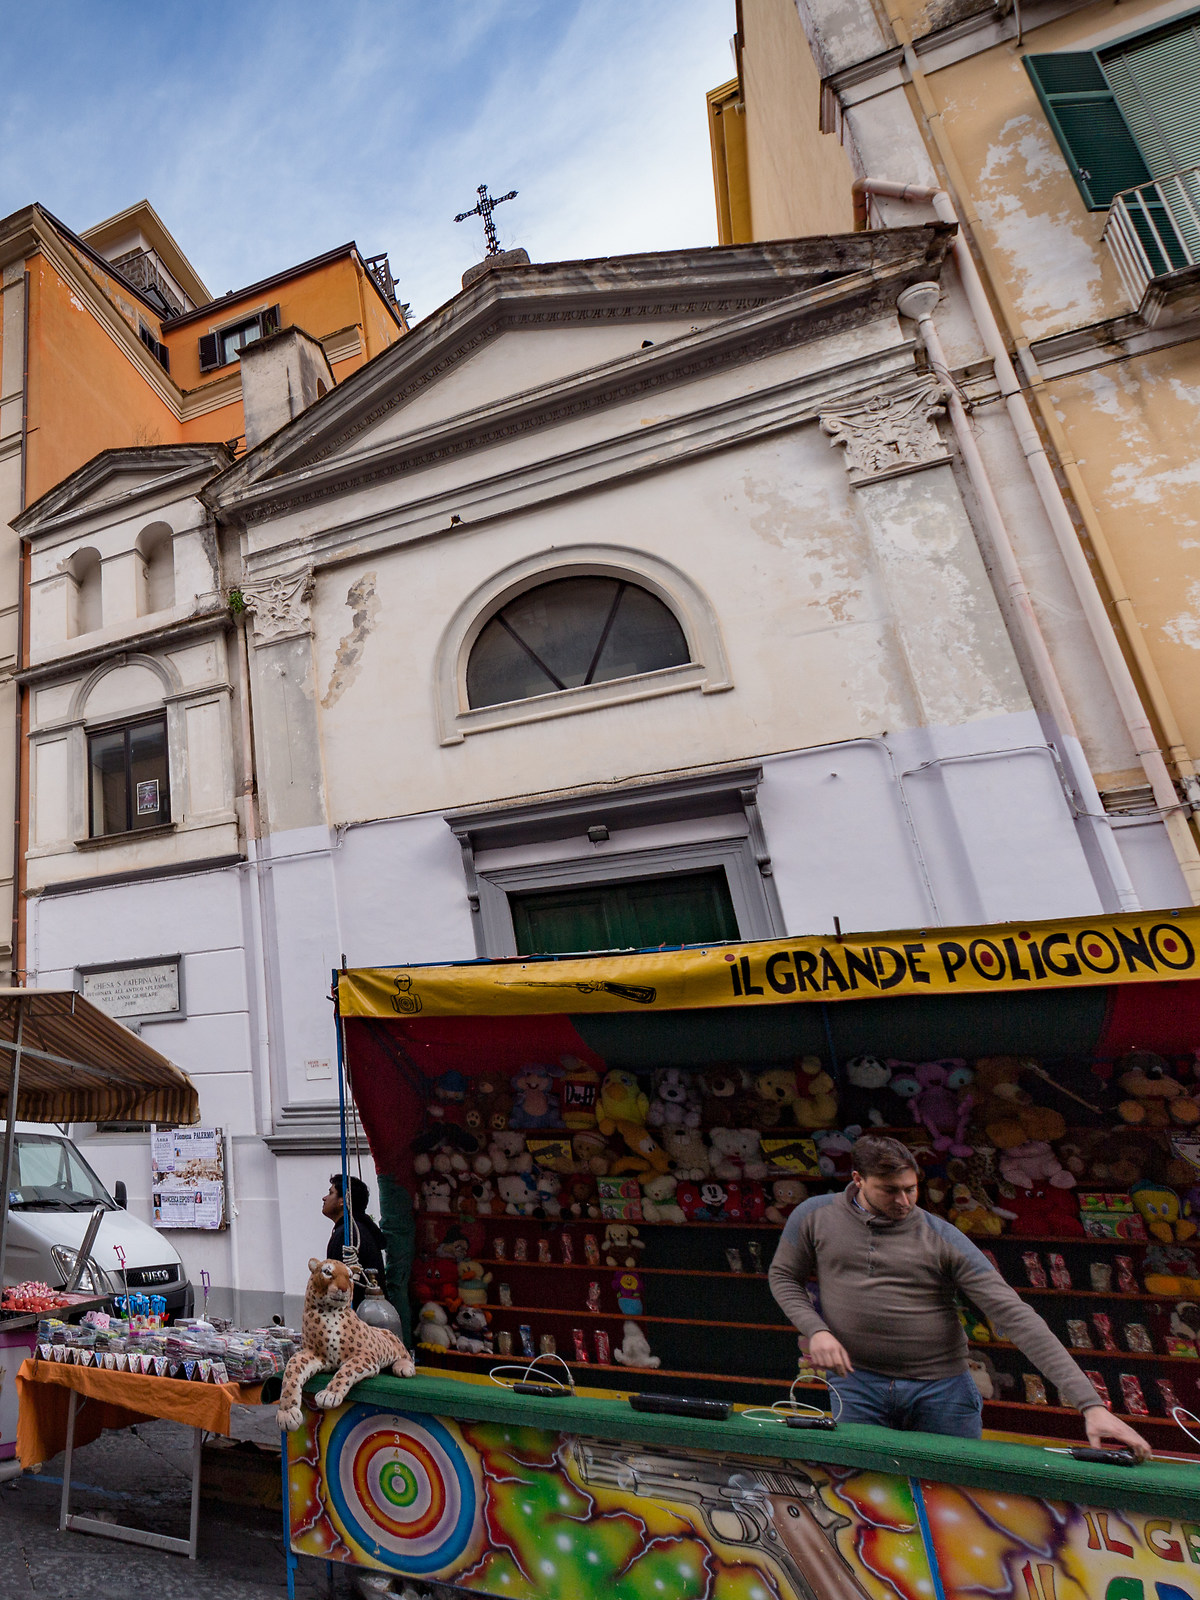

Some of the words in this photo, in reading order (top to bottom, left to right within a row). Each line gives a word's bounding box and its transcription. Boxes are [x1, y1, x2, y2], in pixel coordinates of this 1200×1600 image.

[765, 943, 930, 995] GRANDE
[193, 1131, 214, 1140] PALERMO
[141, 1269, 170, 1283] IVECO
[393, 1417, 399, 1427] 2
[393, 1434, 400, 1444] 3
[393, 1449, 399, 1459] 4
[394, 1464, 401, 1474] 5
[1082, 1511, 1134, 1560] IL
